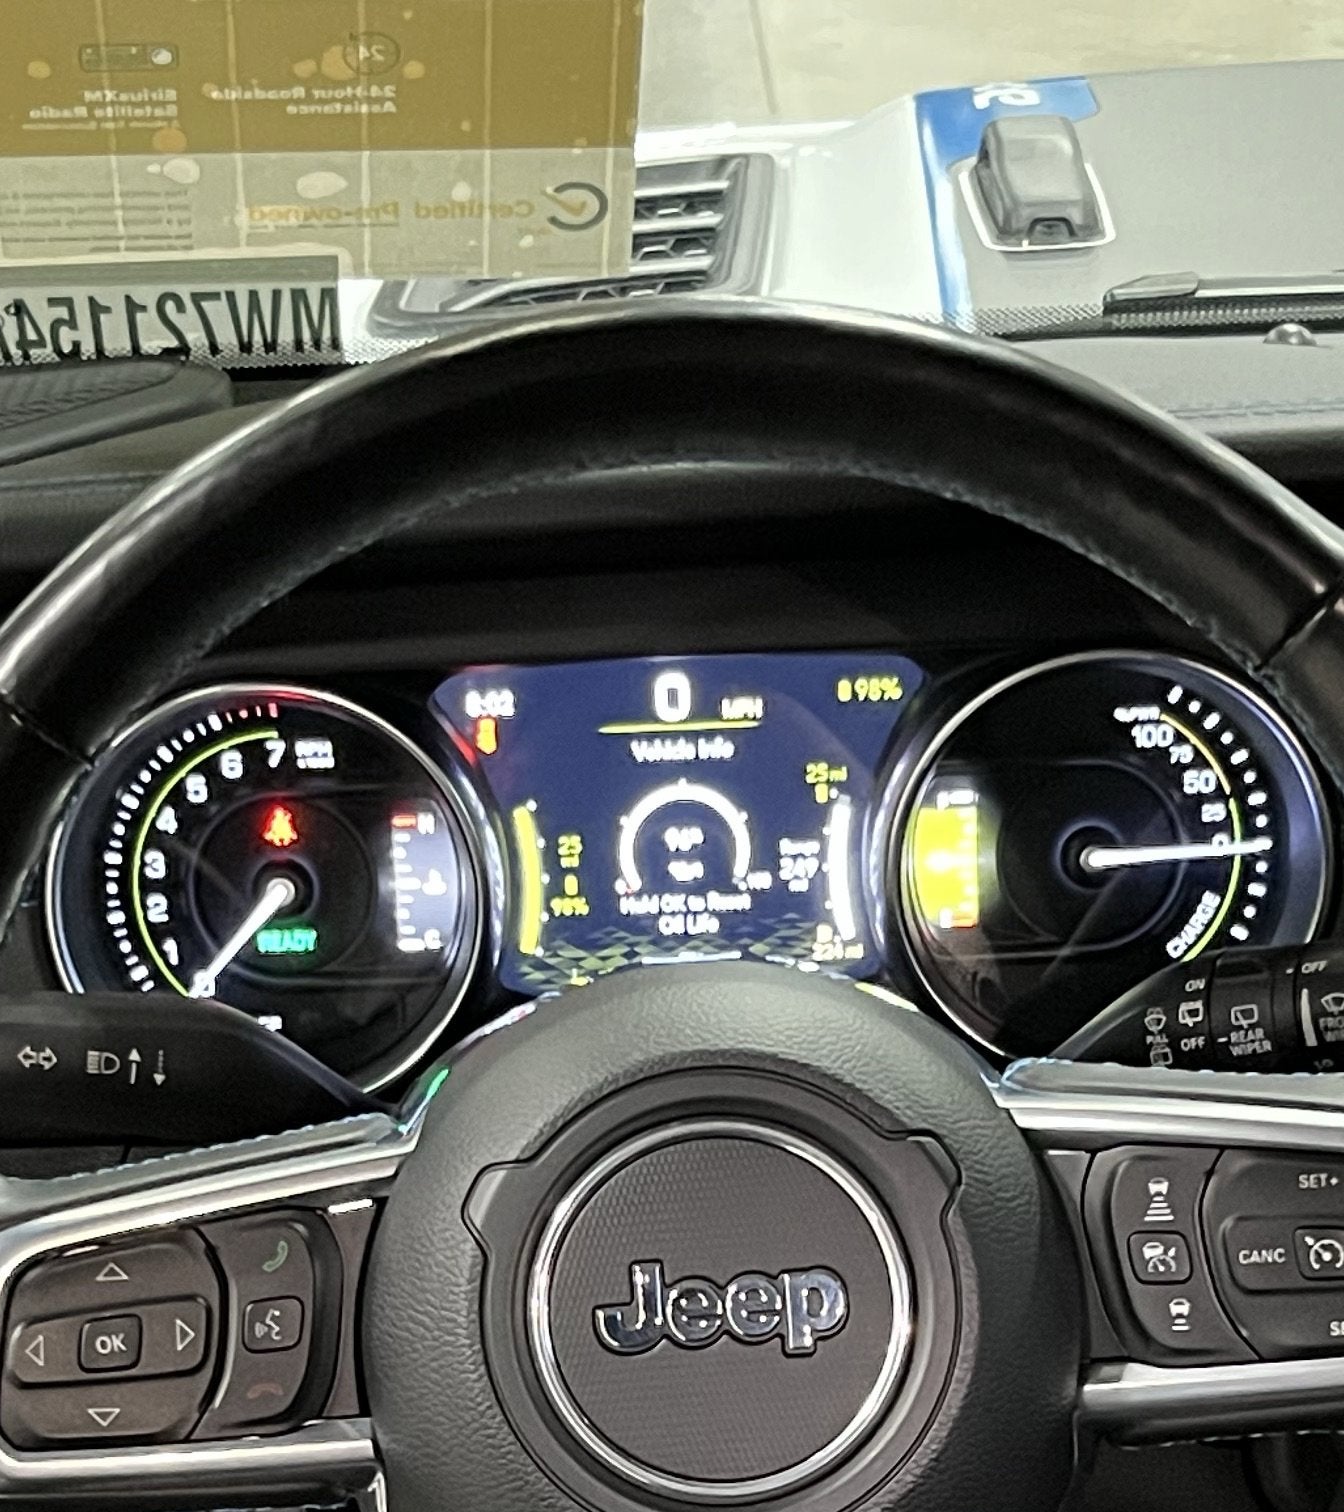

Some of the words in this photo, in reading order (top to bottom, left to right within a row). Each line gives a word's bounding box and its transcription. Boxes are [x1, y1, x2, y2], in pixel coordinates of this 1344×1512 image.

[654, 671, 692, 722] 0
[853, 677, 904, 702] 98%
[1131, 723, 1175, 750] 100
[220, 751, 244, 779] 6
[265, 739, 288, 768] 7
[1169, 743, 1195, 765] 75
[805, 762, 829, 784] 25
[1183, 769, 1218, 795] 50
[185, 775, 209, 803] 5
[155, 807, 178, 834] 4
[144, 852, 166, 880] 3
[147, 896, 169, 924] 2
[1165, 889, 1221, 959] CHARGE
[162, 938, 178, 966] 1
[1301, 960, 1328, 975] OFF
[1184, 978, 1206, 993] ON
[1180, 1036, 1206, 1052] OFF
[1229, 1040, 1272, 1057] WIPER
[1230, 1027, 1265, 1044] REAR
[1238, 1248, 1286, 1265] CANC
[594, 1259, 849, 1357] Jeep
[94, 1332, 128, 1355] OK
